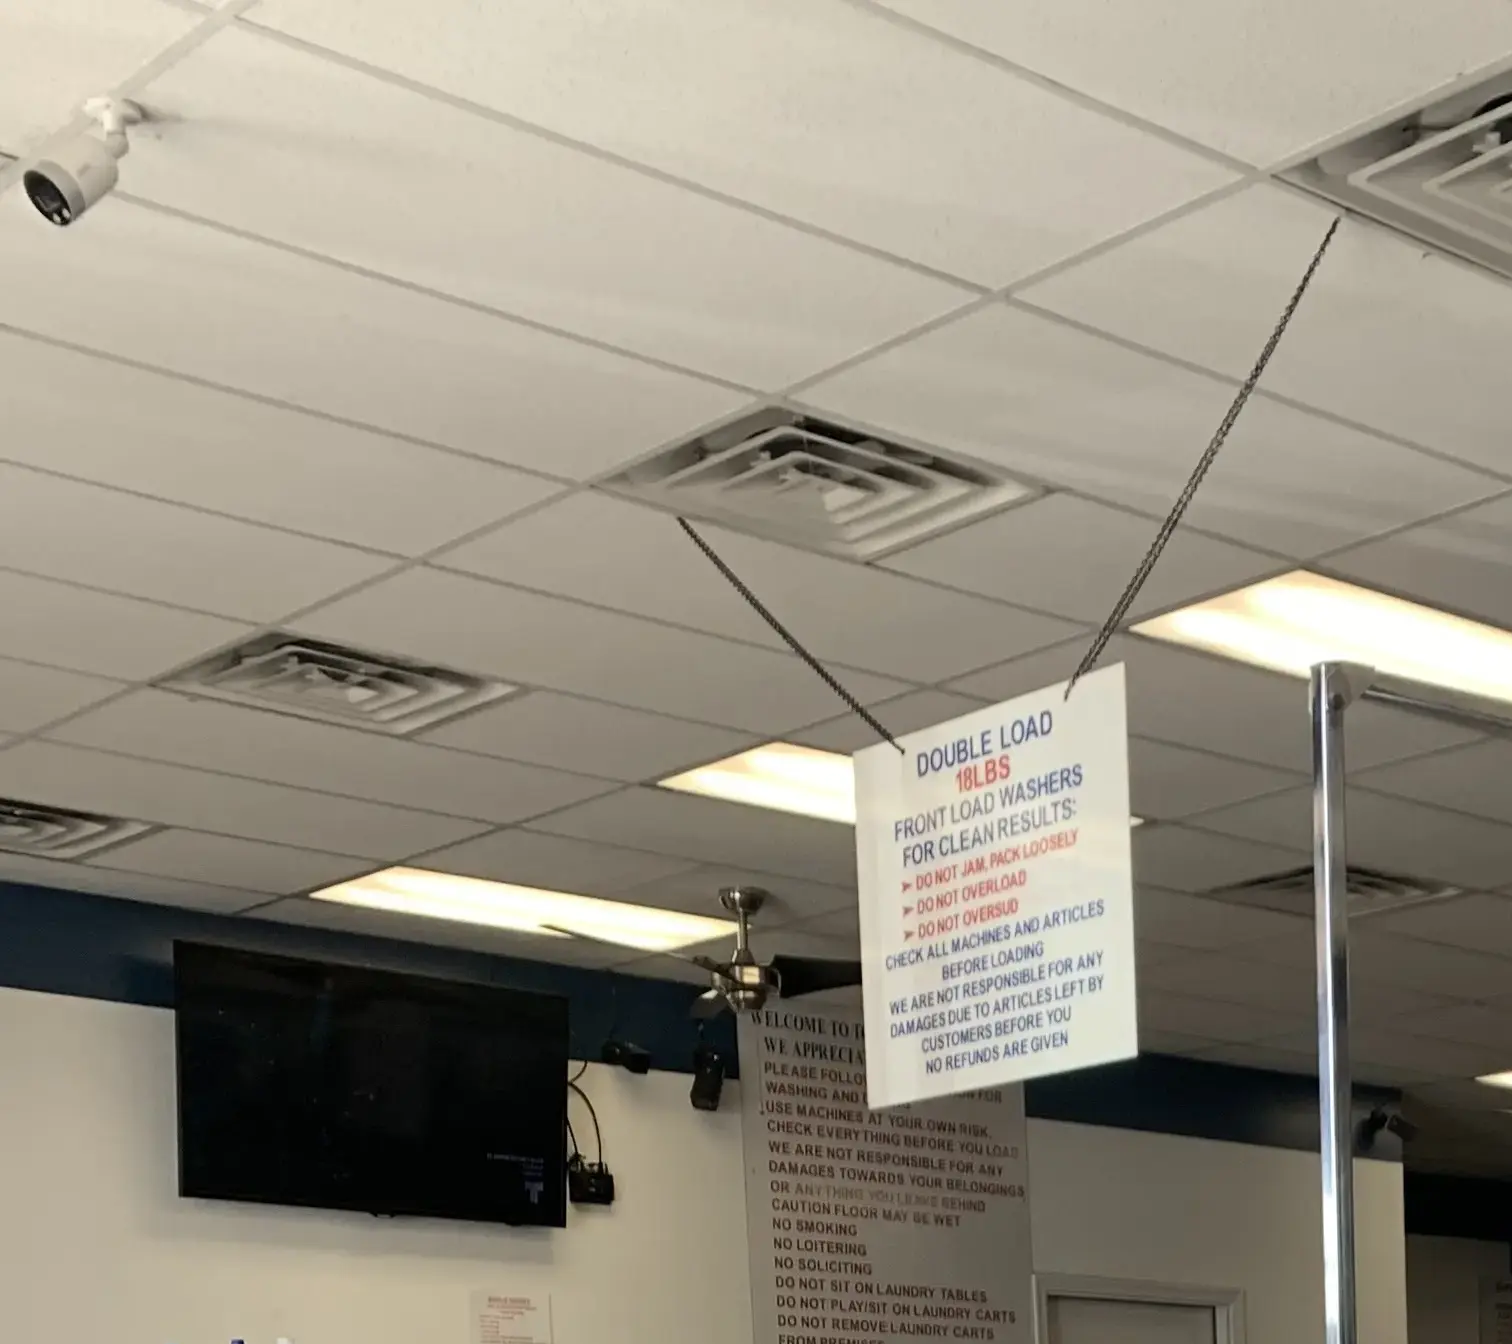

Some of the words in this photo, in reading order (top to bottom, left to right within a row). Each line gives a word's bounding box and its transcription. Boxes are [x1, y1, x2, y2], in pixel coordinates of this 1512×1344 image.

[916, 728, 992, 778] DOUBLE
[999, 708, 1053, 750] LOAD
[955, 752, 1011, 794] 18LBS
[893, 805, 947, 842] FRONT
[950, 790, 995, 825] LOAD
[998, 762, 1083, 810] WASHERS
[902, 838, 934, 868] FOR
[938, 820, 994, 857] CLEAN
[997, 795, 1077, 840] RESULTS:
[915, 871, 933, 891] DO
[934, 864, 957, 885] NOT
[989, 845, 1020, 869] PACK
[1022, 827, 1079, 860] LOOSELY
[916, 895, 934, 915] DO
[935, 888, 958, 910] NOT
[961, 868, 1027, 902] OVERLOAD
[885, 946, 923, 971] CHECK
[926, 940, 948, 960] ALL
[950, 923, 1011, 954] MACHINES
[1013, 915, 1040, 937] AND
[1042, 898, 1104, 930] ARTICLES
[917, 920, 935, 939] DO
[936, 913, 959, 934] NOT
[962, 897, 1018, 927] OVERSUD
[941, 954, 988, 981] BEFORE
[991, 939, 1045, 968] LOADING
[889, 997, 908, 1017] WE
[909, 991, 934, 1012] ARE
[936, 985, 960, 1005] NOT
[962, 964, 1045, 999] RESPONSIBLE
[1047, 957, 1073, 978] FOR
[1076, 949, 1104, 971] ANY
[750, 1010, 829, 1036] WELCOME
[832, 1022, 850, 1039] TO
[889, 1011, 946, 1039] DAMAGES
[947, 1005, 971, 1025] DUE
[973, 1000, 990, 1019] TO
[992, 986, 1052, 1015] ARTICLES
[1054, 978, 1086, 1001] LEFT
[1088, 974, 1104, 993] BY
[762, 1036, 788, 1055] WE
[921, 1023, 992, 1054] CUSTOMERS
[994, 1011, 1044, 1037] BEFORE
[1046, 1005, 1071, 1025] YOU
[763, 1059, 816, 1080] PLEASE
[925, 1057, 942, 1075] NO
[944, 1044, 1000, 1071] REFUNDS
[1001, 1038, 1029, 1058] ARE
[1030, 1029, 1069, 1052] GIVEN
[764, 1079, 828, 1100] WASHING
[831, 1088, 859, 1104] AND
[765, 1099, 793, 1116] USE
[795, 1103, 864, 1124] MACHINES
[867, 1112, 883, 1126] AT
[887, 1114, 923, 1131] YOUR
[925, 1119, 957, 1135] OWN
[766, 1118, 813, 1136] CHECK
[903, 1134, 954, 1152] BEFORE
[956, 1140, 983, 1155] YOU
[767, 1139, 791, 1155] WE
[793, 1142, 823, 1158] ARE
[826, 1145, 853, 1161] NOT
[856, 1149, 946, 1171] RESPONSIBLE
[948, 1159, 974, 1175] FOR
[977, 1162, 1004, 1178] ANY
[768, 1159, 835, 1179] DAMAGES
[838, 1166, 904, 1186] TOWARDS
[908, 1174, 942, 1190] YOUR
[769, 1179, 790, 1194] OR
[771, 1216, 792, 1231] NO
[795, 1218, 858, 1237] SMOKING
[834, 1203, 878, 1220] FLOOR
[772, 1236, 793, 1251] NO
[796, 1238, 867, 1257] LOITERING
[773, 1255, 794, 1270] NO
[797, 1257, 873, 1276] SOLICITING
[774, 1275, 795, 1289] DO
[798, 1276, 826, 1292] NOT
[829, 1279, 851, 1293] SIT
[853, 1281, 874, 1295] ON
[875, 1282, 936, 1299] LAUNDRY
[939, 1287, 987, 1303] TABLES
[775, 1294, 796, 1309] DO
[799, 1296, 827, 1311] NOT
[913, 1304, 971, 1321] LAUNDRY
[974, 1308, 1016, 1324] CARTS
[776, 1314, 797, 1328] DO
[800, 1315, 828, 1330] NOT
[831, 1317, 888, 1334] REMOVE
[889, 1321, 949, 1337] LAUNDRY
[952, 1325, 994, 1340] CARTS
